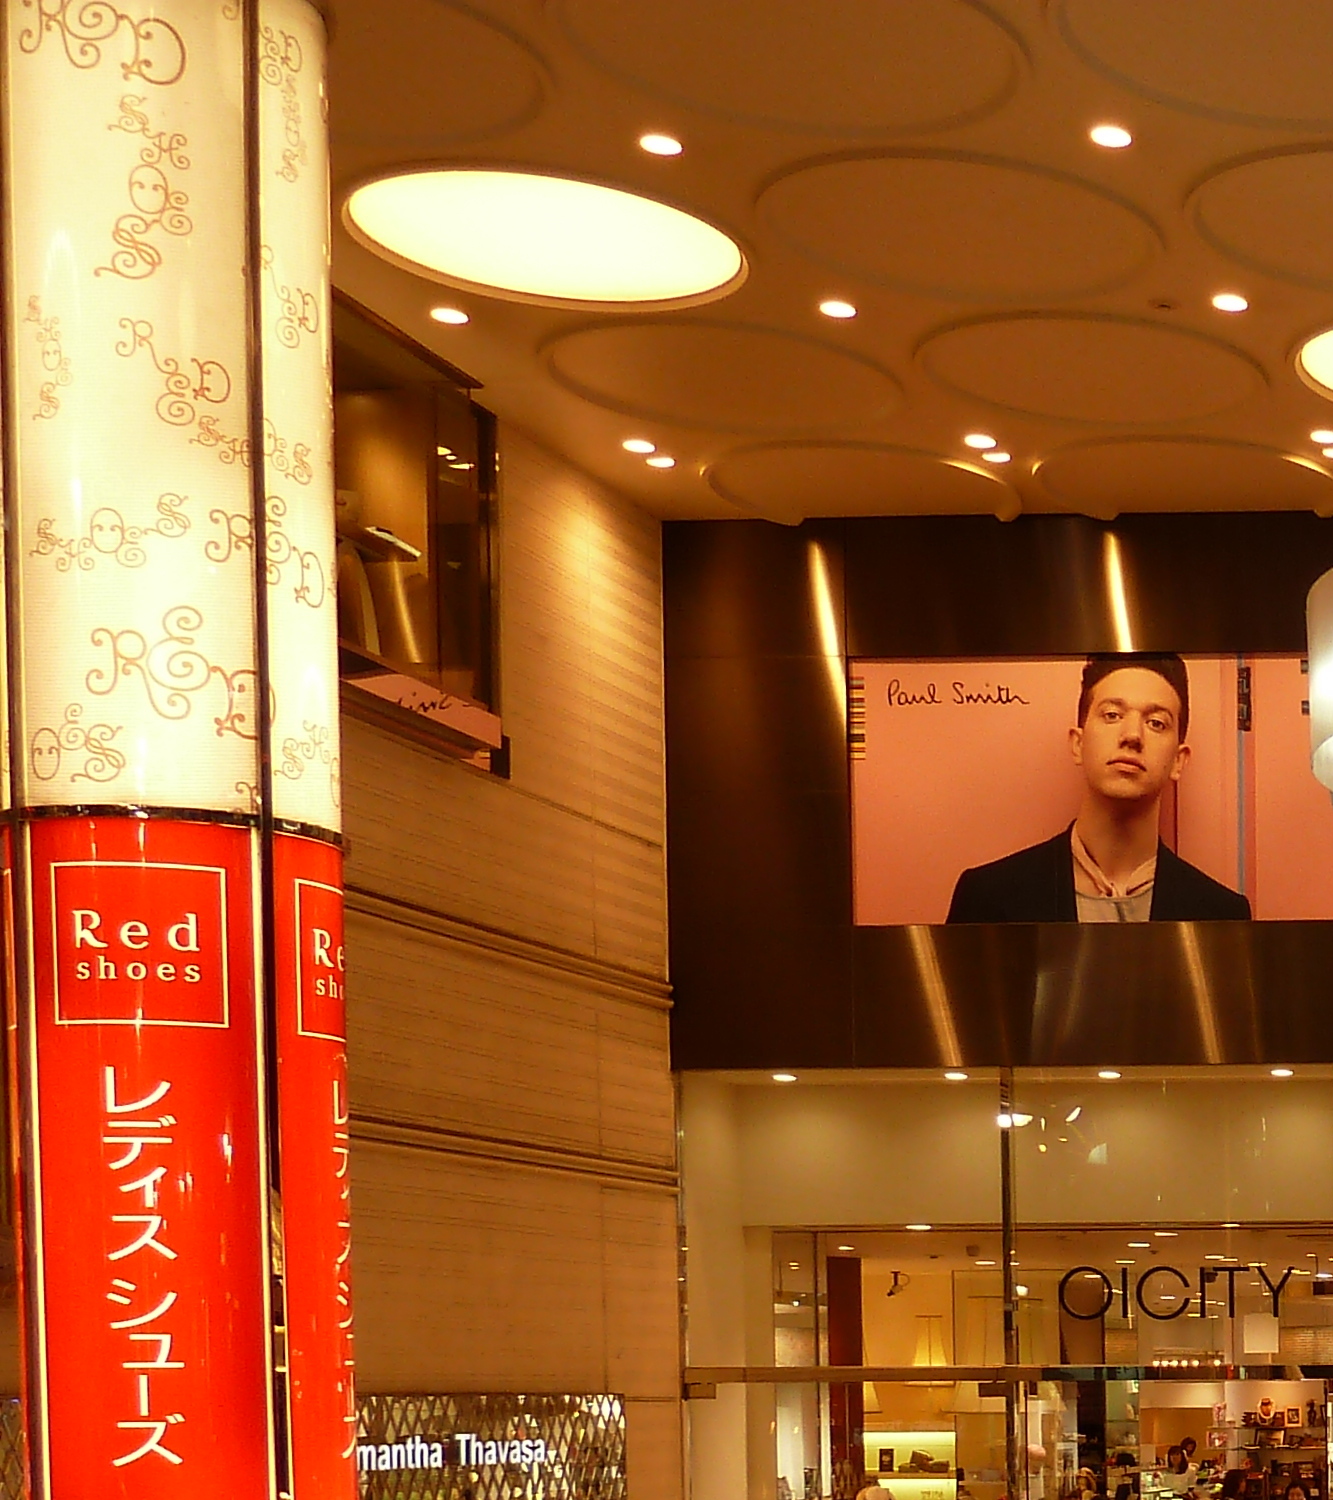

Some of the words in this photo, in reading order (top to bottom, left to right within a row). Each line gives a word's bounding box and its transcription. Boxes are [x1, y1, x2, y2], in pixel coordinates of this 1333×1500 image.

[887, 679, 942, 706] Paul
[952, 681, 1030, 705] Smith
[72, 909, 200, 952] Red
[76, 956, 201, 983] shoes
[1058, 1266, 1295, 1320] OICITY
[455, 1433, 546, 1466] Thavasa
